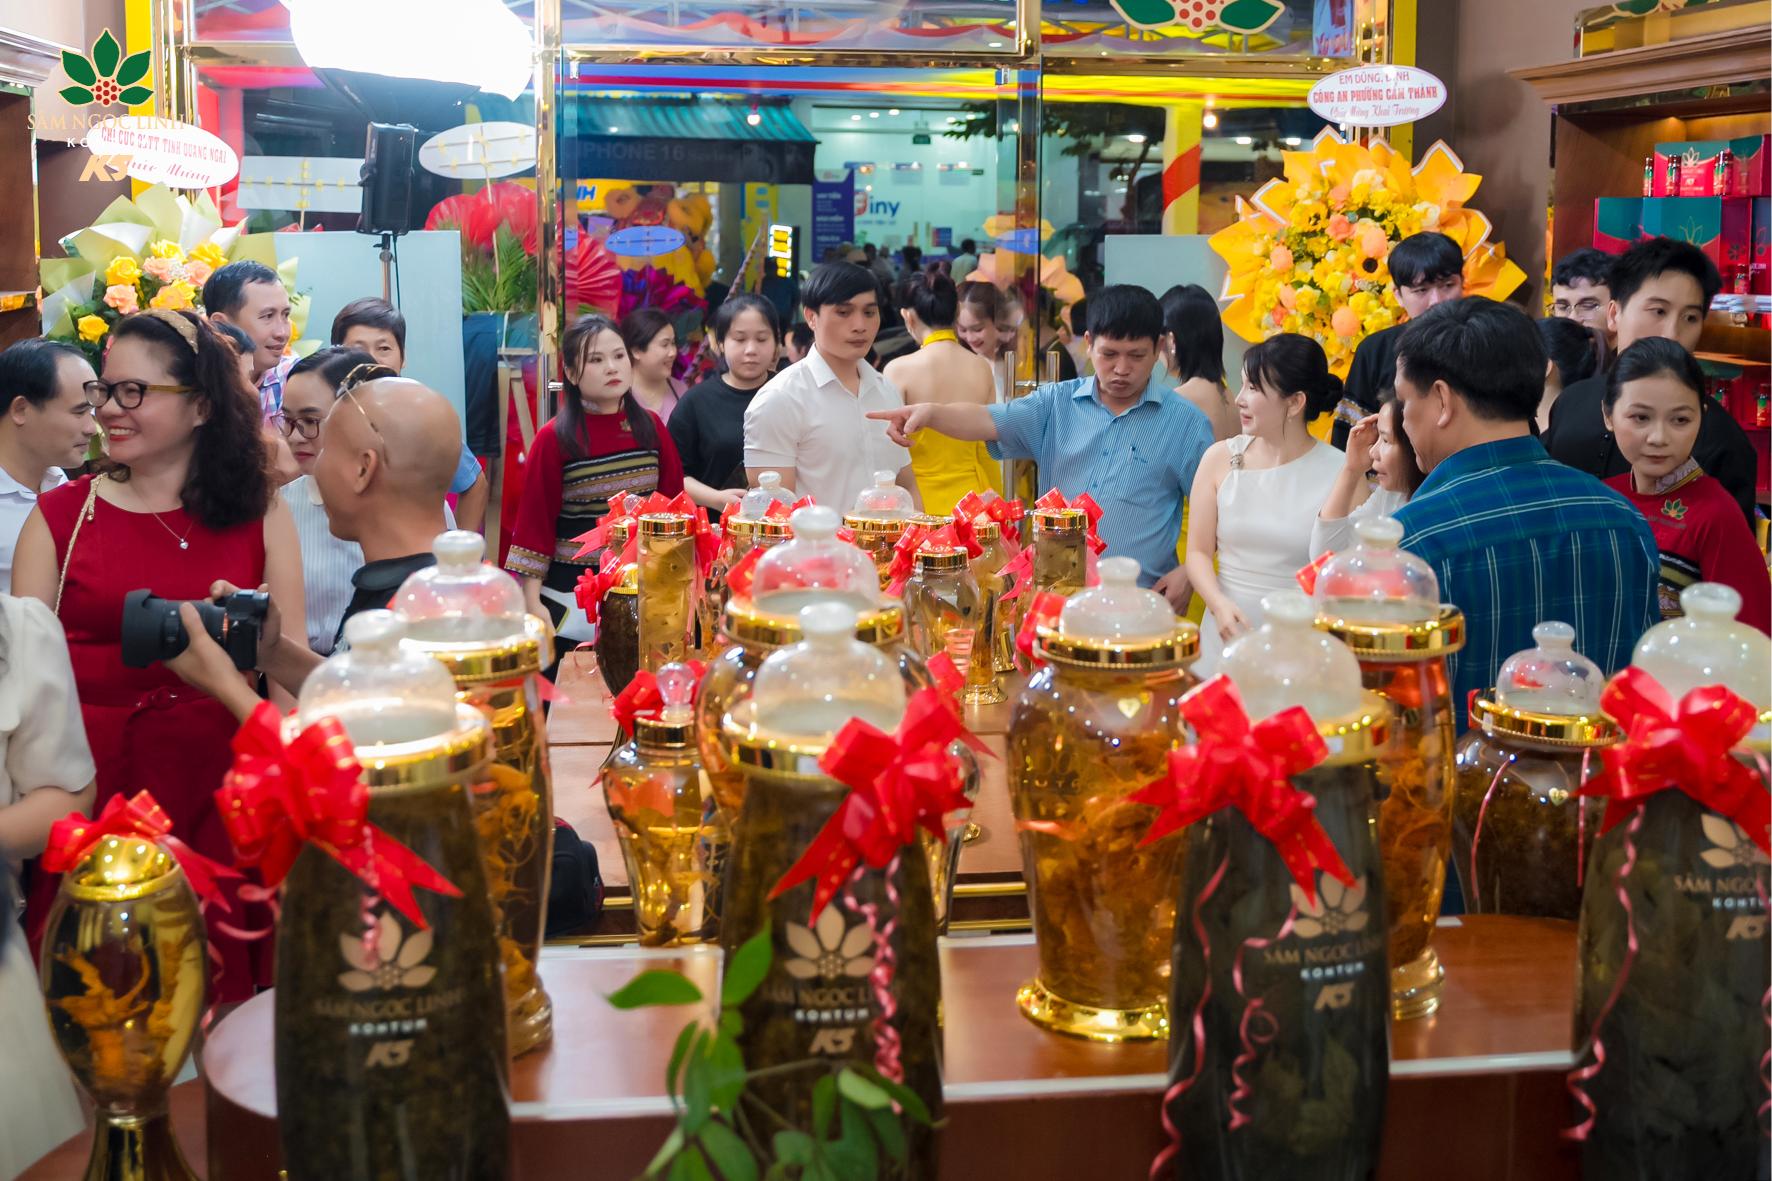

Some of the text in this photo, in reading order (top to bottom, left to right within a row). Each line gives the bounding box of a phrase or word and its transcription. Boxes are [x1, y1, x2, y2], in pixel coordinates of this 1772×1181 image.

[1338, 74, 1353, 85] EM
[1313, 89, 1335, 104] CÔNG
[1337, 90, 1349, 103] AN
[660, 143, 685, 162] 16
